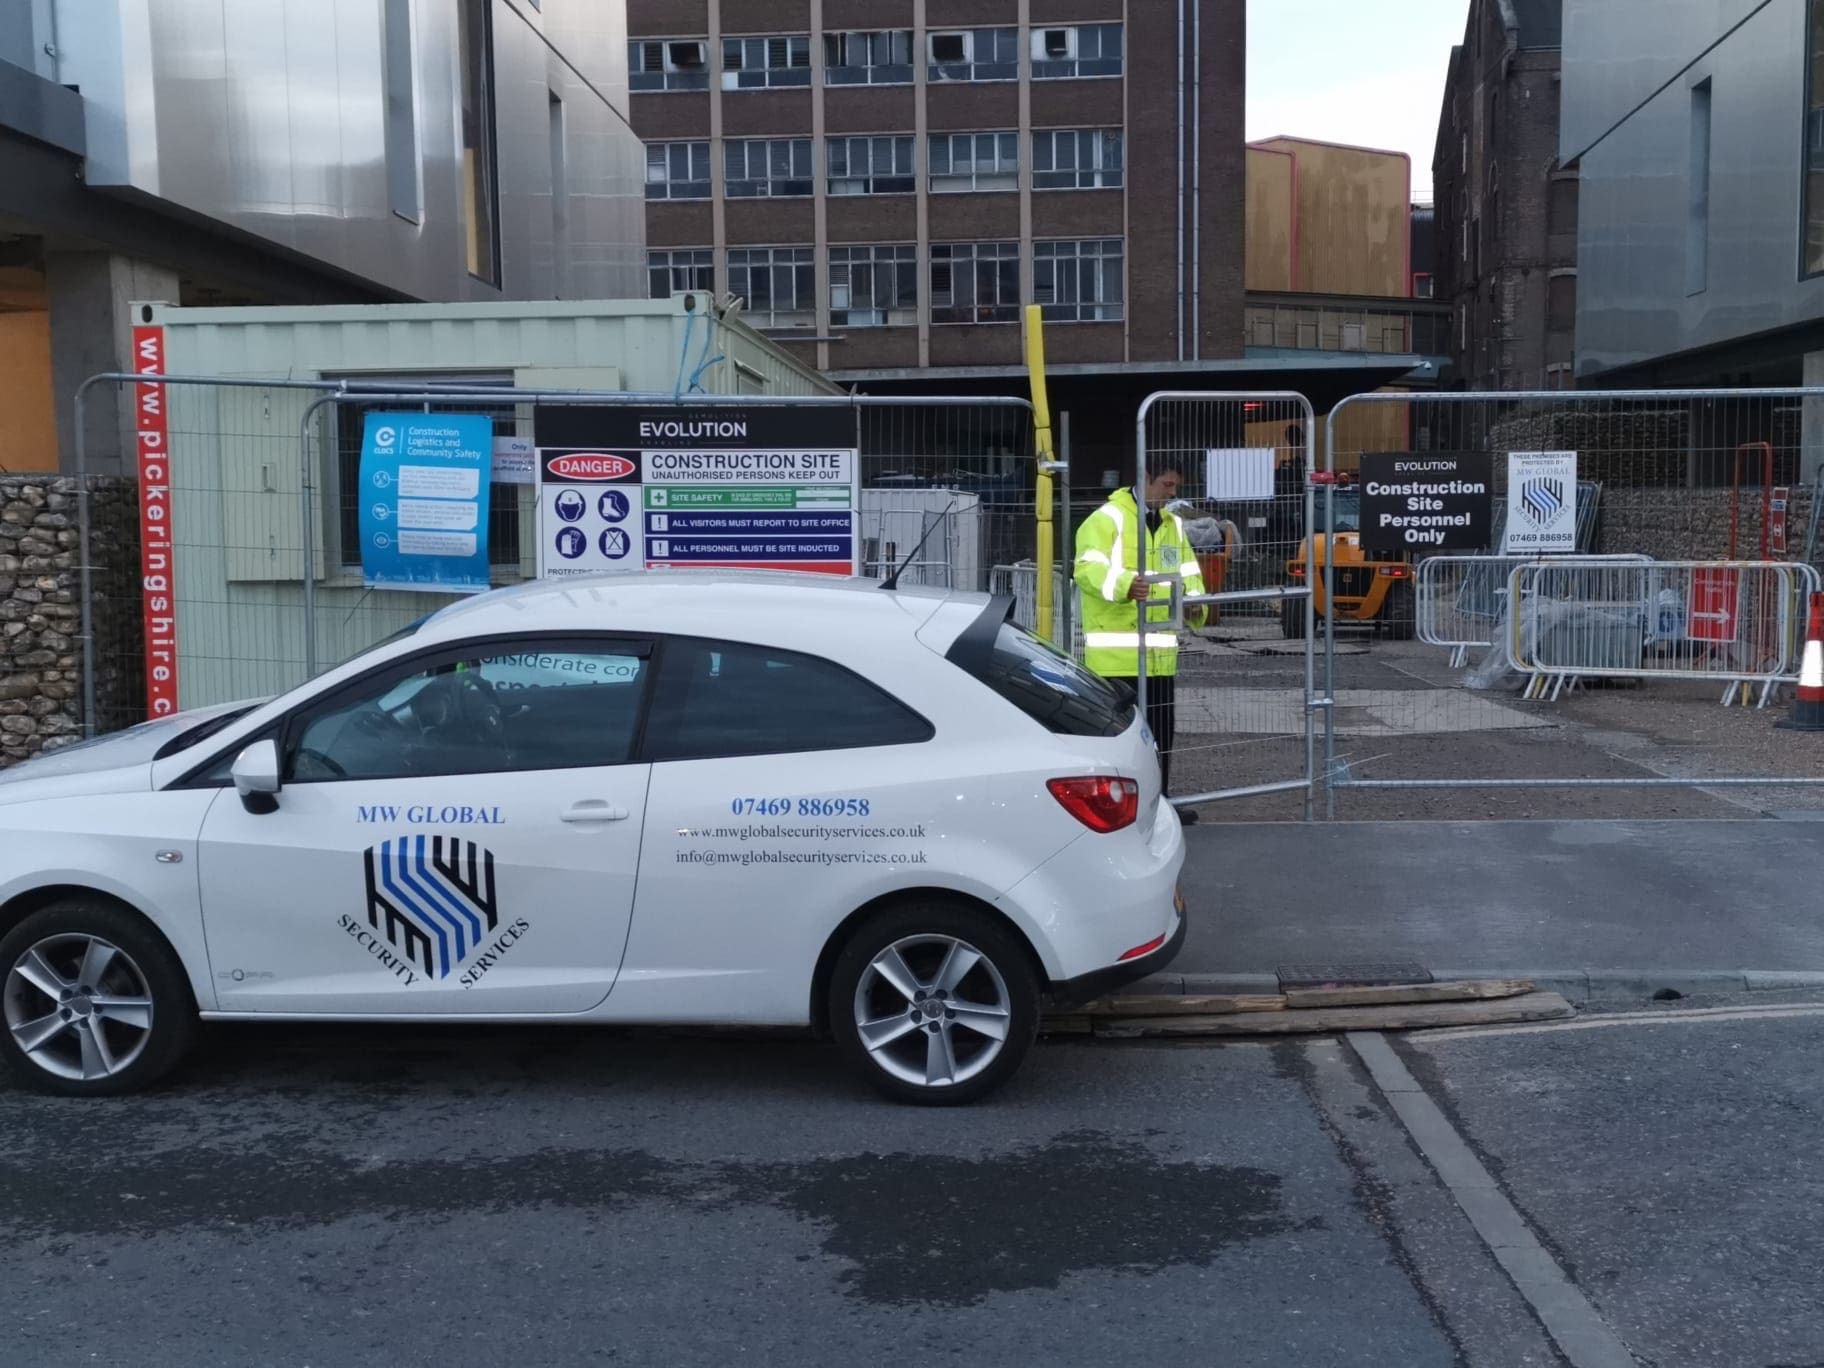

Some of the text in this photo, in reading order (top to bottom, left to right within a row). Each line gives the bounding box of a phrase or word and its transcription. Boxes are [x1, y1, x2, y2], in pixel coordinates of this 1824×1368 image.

[408, 426, 460, 437] Construction
[640, 422, 747, 437] EVOLUTION
[408, 437, 461, 448] Logistics and
[374, 447, 394, 455] CLOCS
[407, 447, 453, 459] Community
[454, 449, 482, 460] Safety
[559, 460, 623, 473] DANGER
[652, 454, 840, 469] CONSTRUCTION SITE
[1394, 461, 1457, 471] EVOLUTION
[652, 471, 840, 480] UNAUTHORISED PERSONS KEEP OUT
[1535, 467, 1569, 475] GLOBAL
[1366, 480, 1485, 496] Construction
[671, 494, 690, 502] SITE
[691, 494, 723, 502] SAFETY
[1407, 497, 1444, 511] Site
[672, 519, 850, 527] ALL VISITORS MUST REPORT TO SITE OFFICE
[1379, 512, 1471, 527] Personnel
[1513, 505, 1541, 533] SECURITY
[1543, 504, 1572, 530] SERVICES
[1404, 528, 1446, 545] Only
[1510, 533, 1573, 542] 07469 886958
[673, 545, 689, 553] ALL
[690, 545, 739, 553] PERSONNEL
[356, 805, 506, 824] MW GLOBAL
[731, 798, 870, 817] 07469 886958
[677, 825, 926, 840] www.mwglobalsecurityservices.co.uk
[676, 850, 927, 866] info@mwglobalsecurityservices.co.uk
[336, 913, 420, 988] SECURITY
[459, 916, 531, 990] SERVICES
